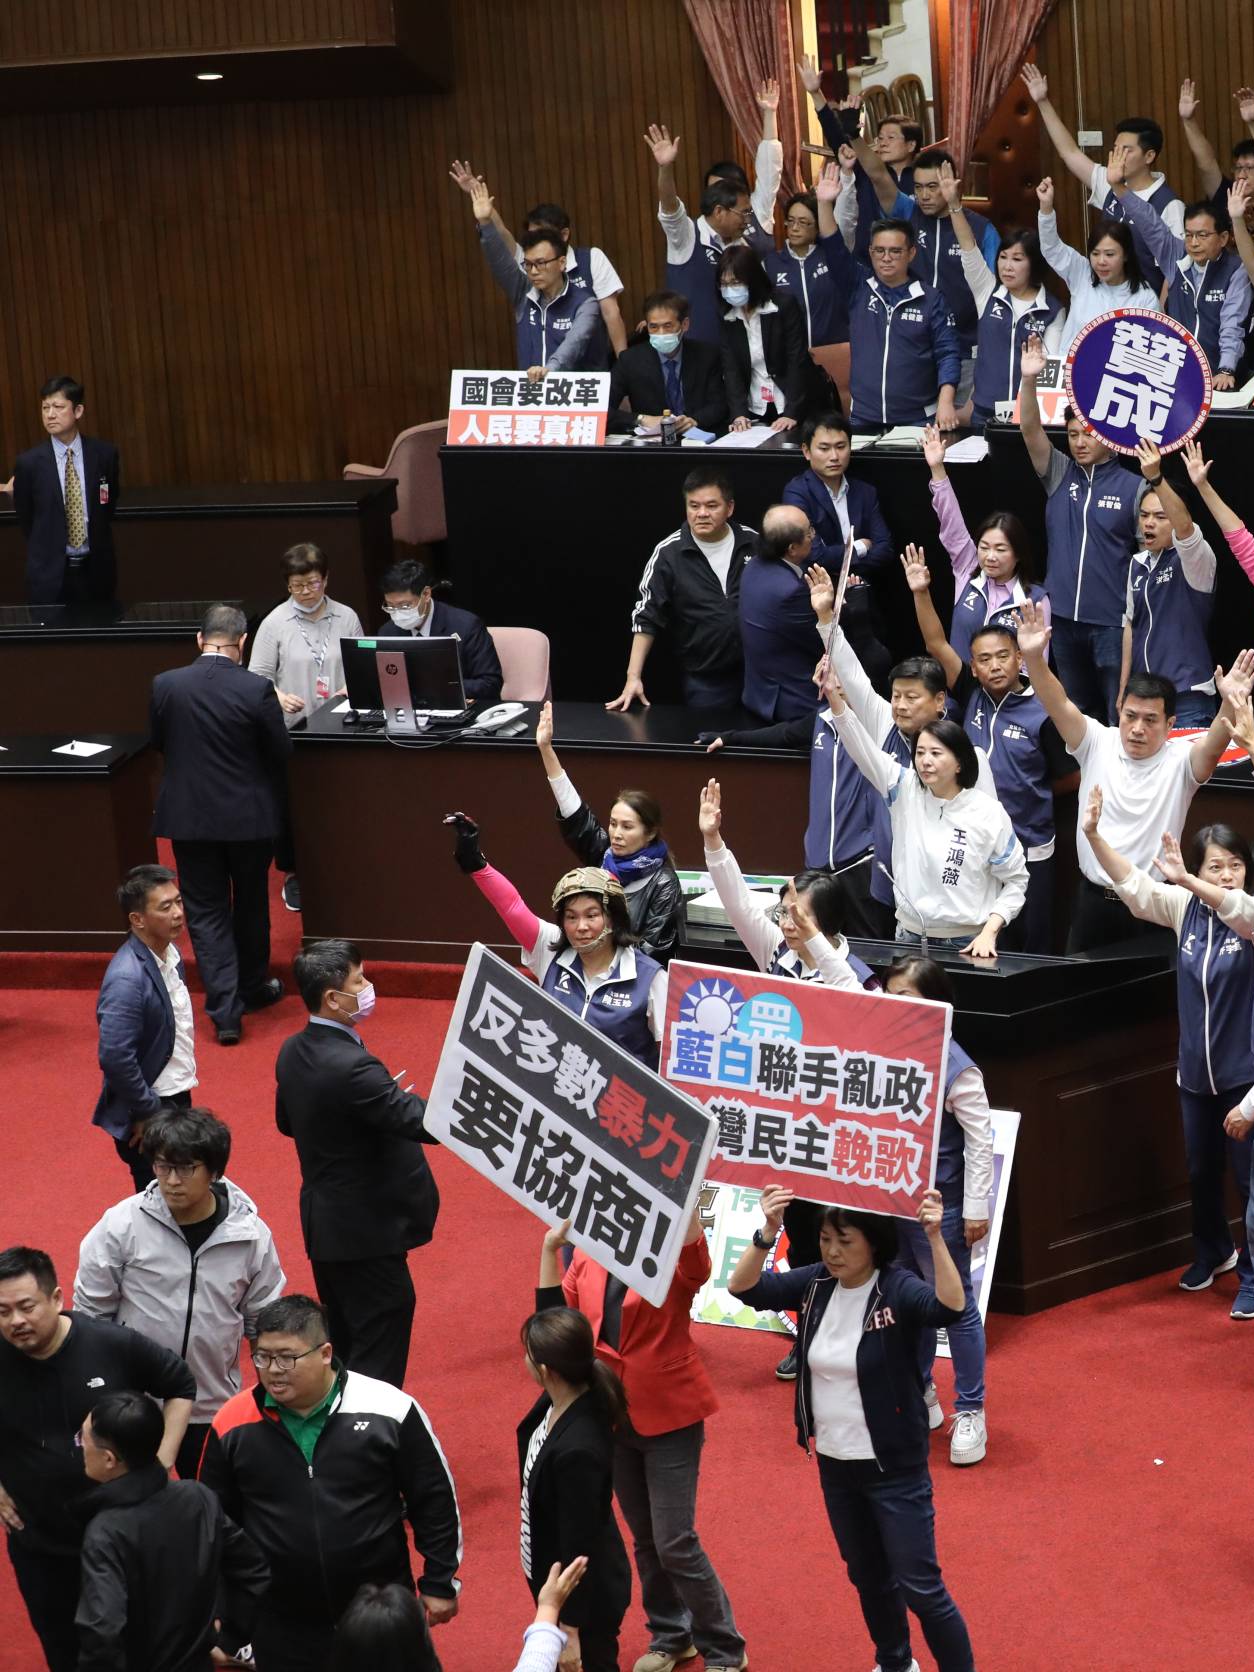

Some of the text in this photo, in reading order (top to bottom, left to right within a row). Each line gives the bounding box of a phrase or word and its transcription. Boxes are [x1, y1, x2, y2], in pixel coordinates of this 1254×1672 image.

[462, 376, 602, 407] 國會要改革
[1089, 320, 1188, 445] 贊成
[457, 414, 599, 446] 人民要真相
[942, 828, 968, 887] 王鴻薇
[601, 994, 633, 1008] 陳玉珍
[468, 981, 691, 1181] 反多數暴力
[673, 1027, 927, 1118] 藍白聯手亂政
[449, 1063, 672, 1279] 要協商!
[709, 1103, 919, 1189] 灣民主輓歌
